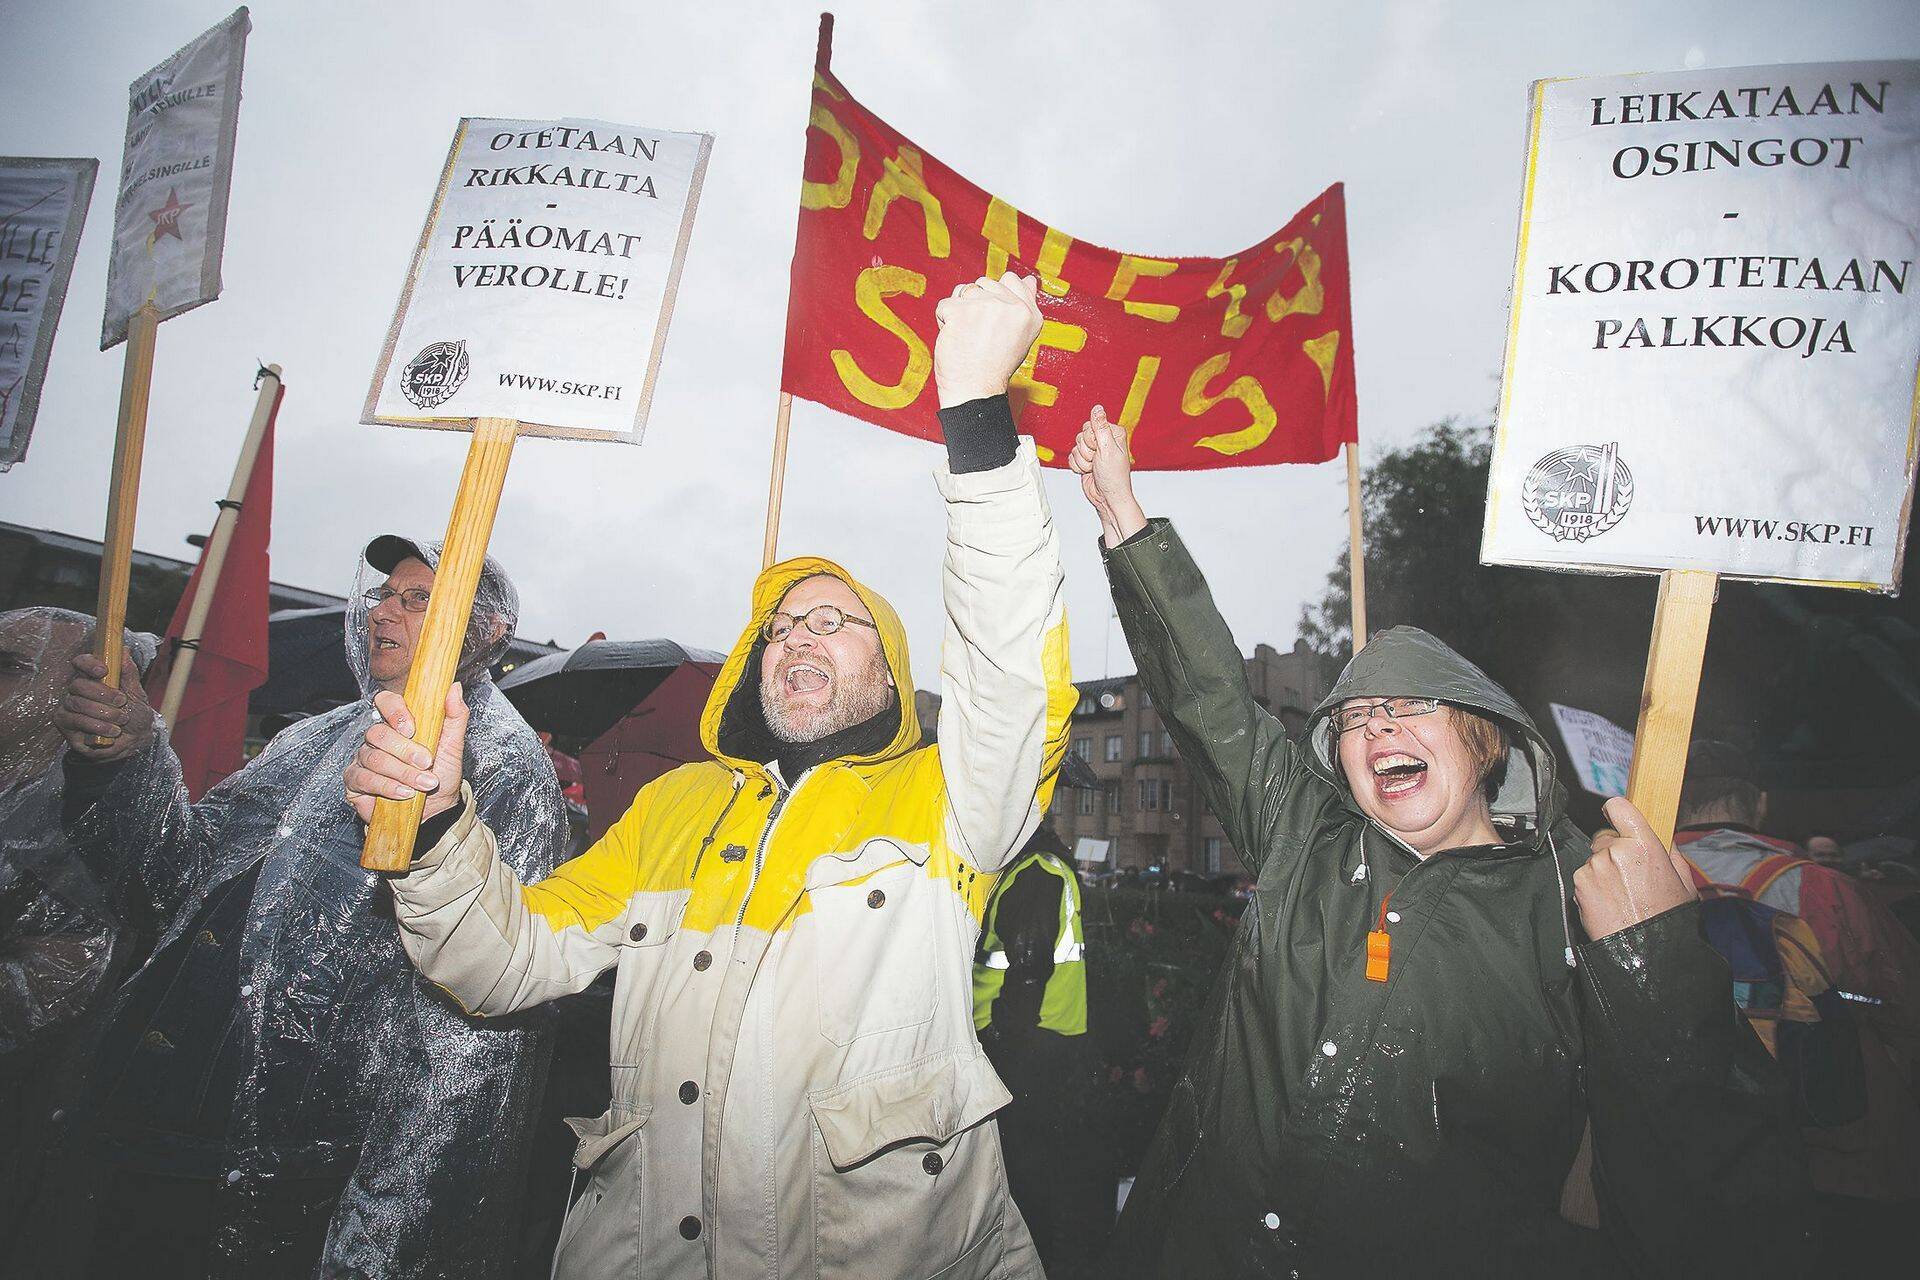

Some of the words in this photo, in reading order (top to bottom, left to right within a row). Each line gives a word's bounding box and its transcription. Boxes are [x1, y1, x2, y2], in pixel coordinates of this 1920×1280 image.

[1590, 80, 1891, 126] LEIKATAAN
[489, 126, 661, 162] OTETAAN
[1612, 137, 1864, 179] OSINGOT
[464, 164, 659, 199] RIKKAILTA
[451, 219, 642, 259] PÄÄOMAT
[453, 265, 629, 300] VEROLLE!
[1546, 256, 1912, 295] KOROTETAAN
[1592, 315, 1857, 358] PALKKOJA
[414, 373, 443, 385] SKP
[422, 388, 441, 396] 1918
[498, 373, 623, 401] WWW.SKP.FI
[1542, 491, 1592, 508] SKP
[1564, 514, 1593, 525] 1918
[1694, 515, 1874, 546] WWW.SKP.FI
